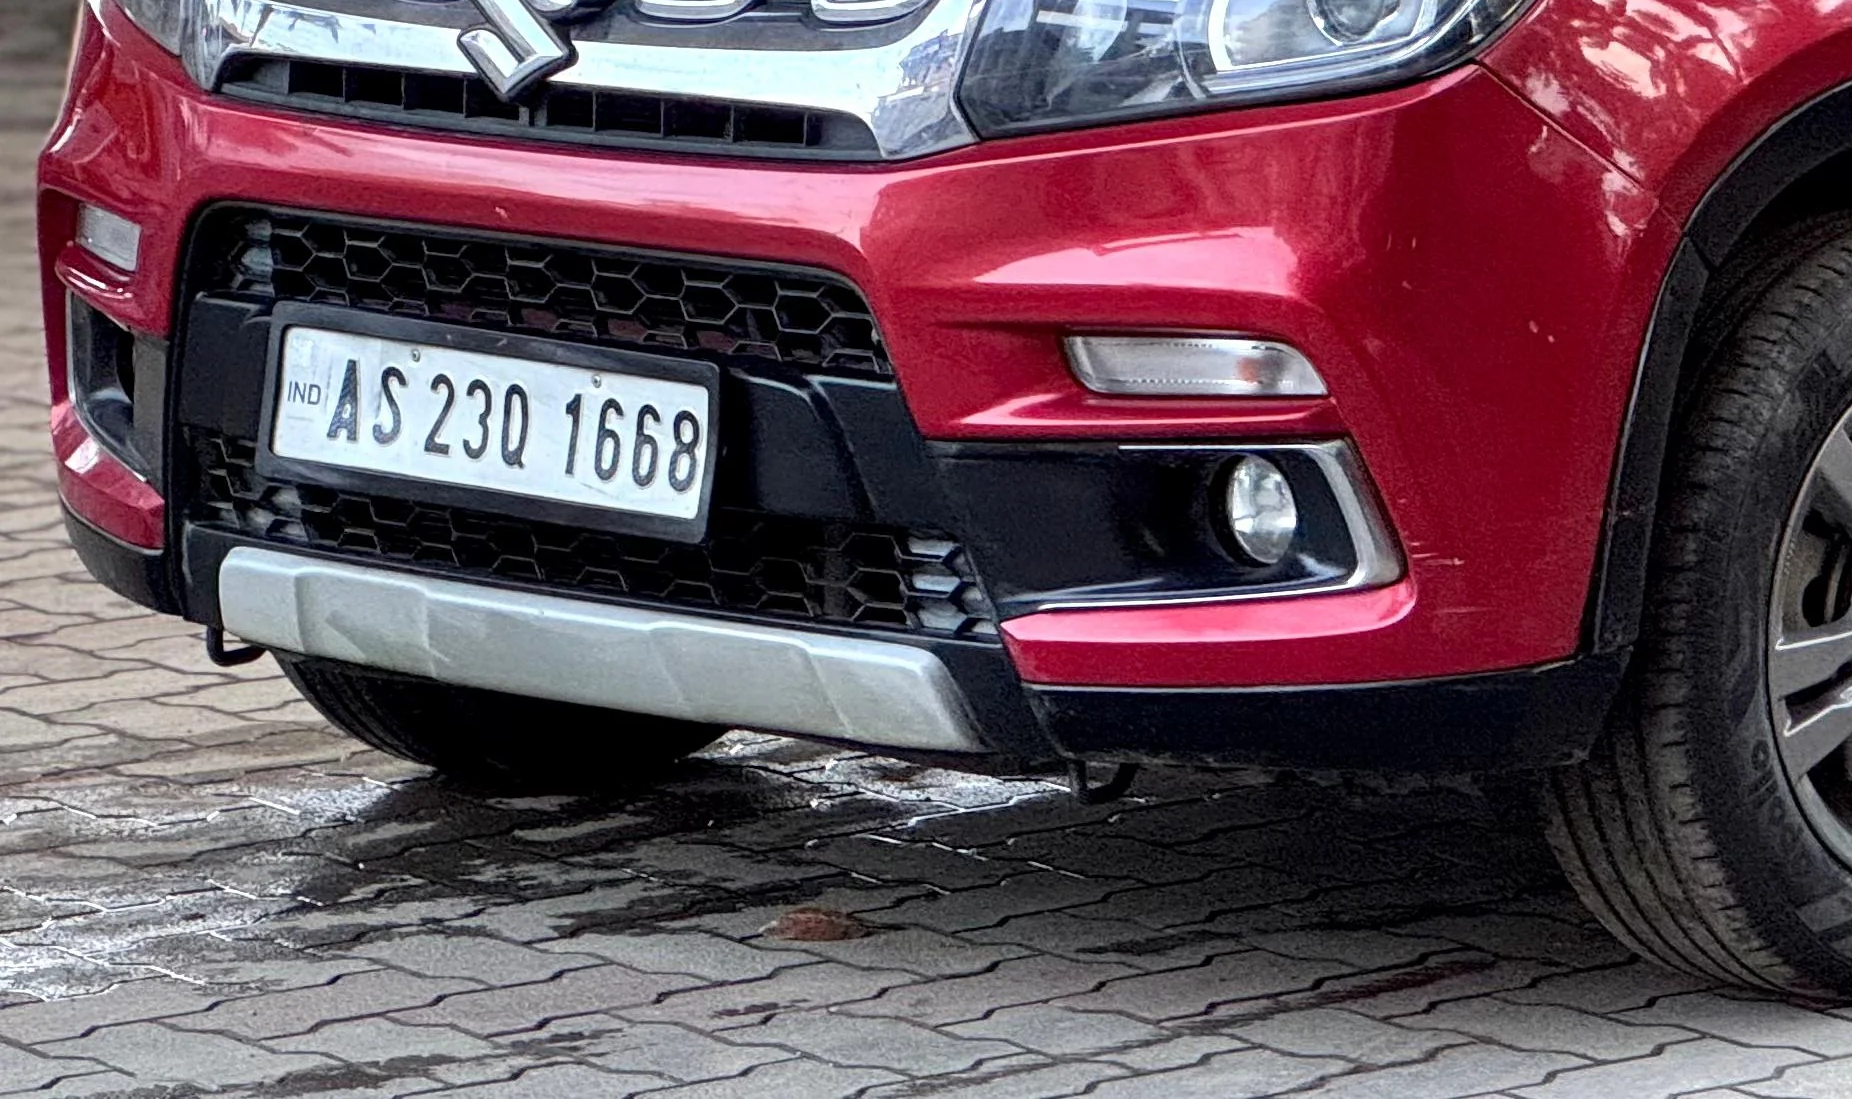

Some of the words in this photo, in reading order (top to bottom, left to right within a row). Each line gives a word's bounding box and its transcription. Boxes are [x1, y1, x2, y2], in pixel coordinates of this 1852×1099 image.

[287, 380, 321, 406] IND
[326, 359, 408, 446] AS
[564, 393, 701, 493] 1668
